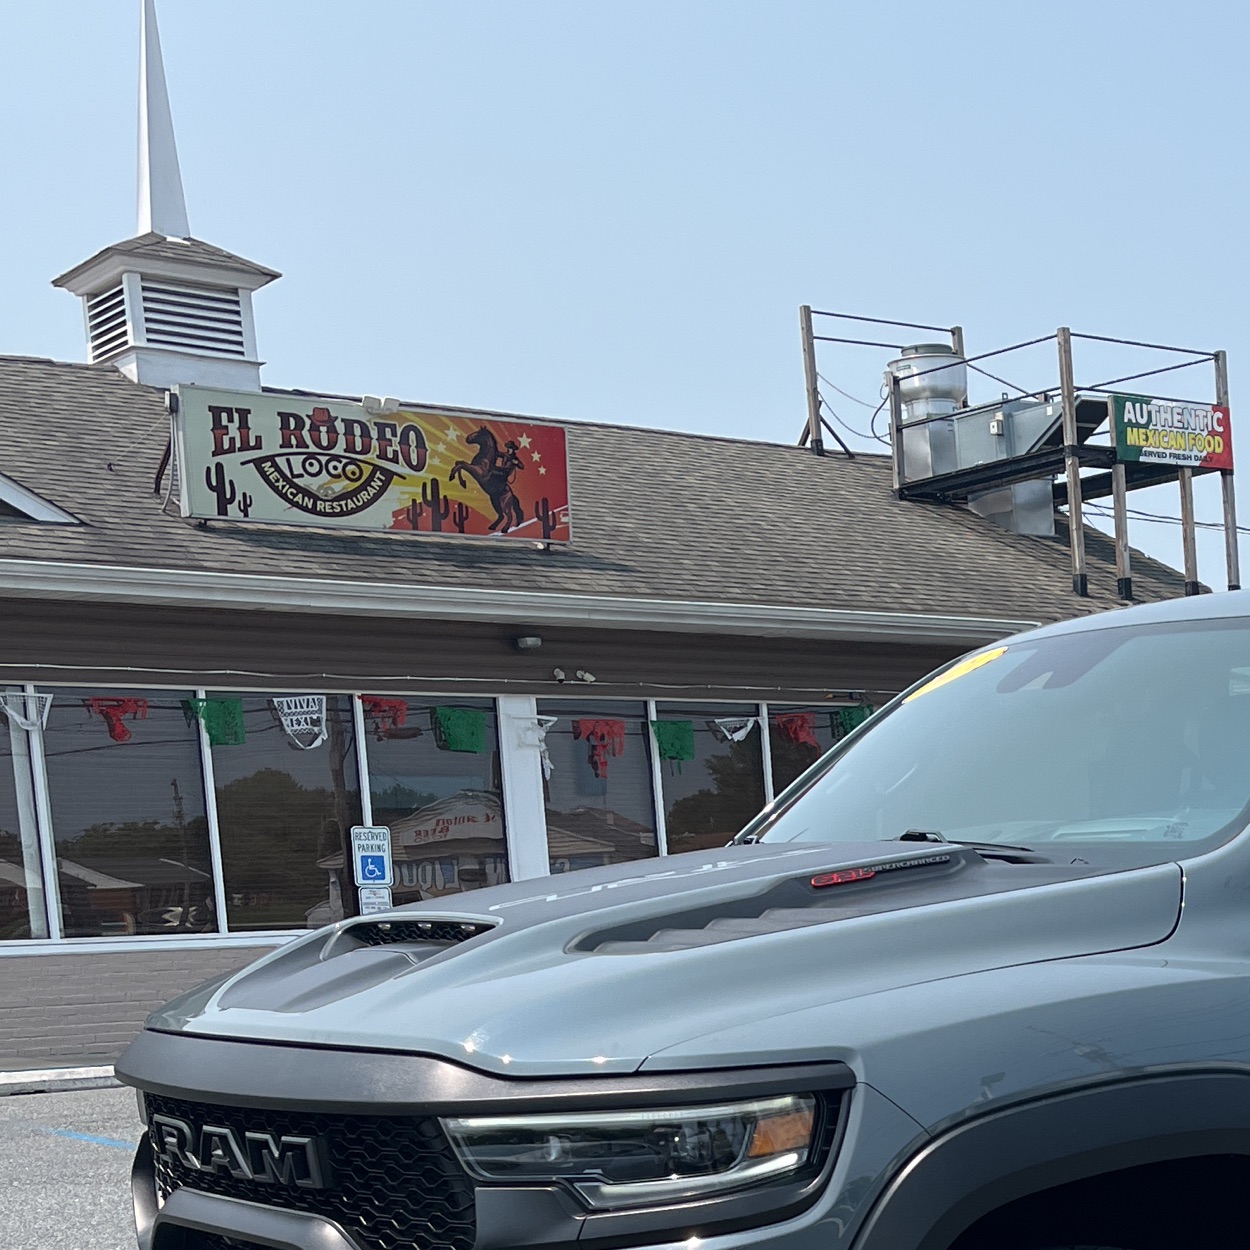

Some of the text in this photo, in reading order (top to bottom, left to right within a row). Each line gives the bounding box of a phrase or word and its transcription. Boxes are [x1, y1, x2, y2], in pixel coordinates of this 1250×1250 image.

[1124, 401, 1224, 432] AUTHENTIC
[208, 405, 429, 472] EL RODEO
[1127, 427, 1224, 454] MEXICAN FOOD
[285, 454, 363, 482] LOCO
[1140, 450, 1214, 463] SERVED FRESH DAILY
[261, 461, 386, 512] MEXICAN RESTAURANT
[284, 698, 319, 710] VIVA
[354, 831, 387, 841] RESERVED
[357, 844, 386, 853] PARKING
[863, 855, 950, 872] SUPERCHARGED
[153, 1113, 324, 1188] RAM
